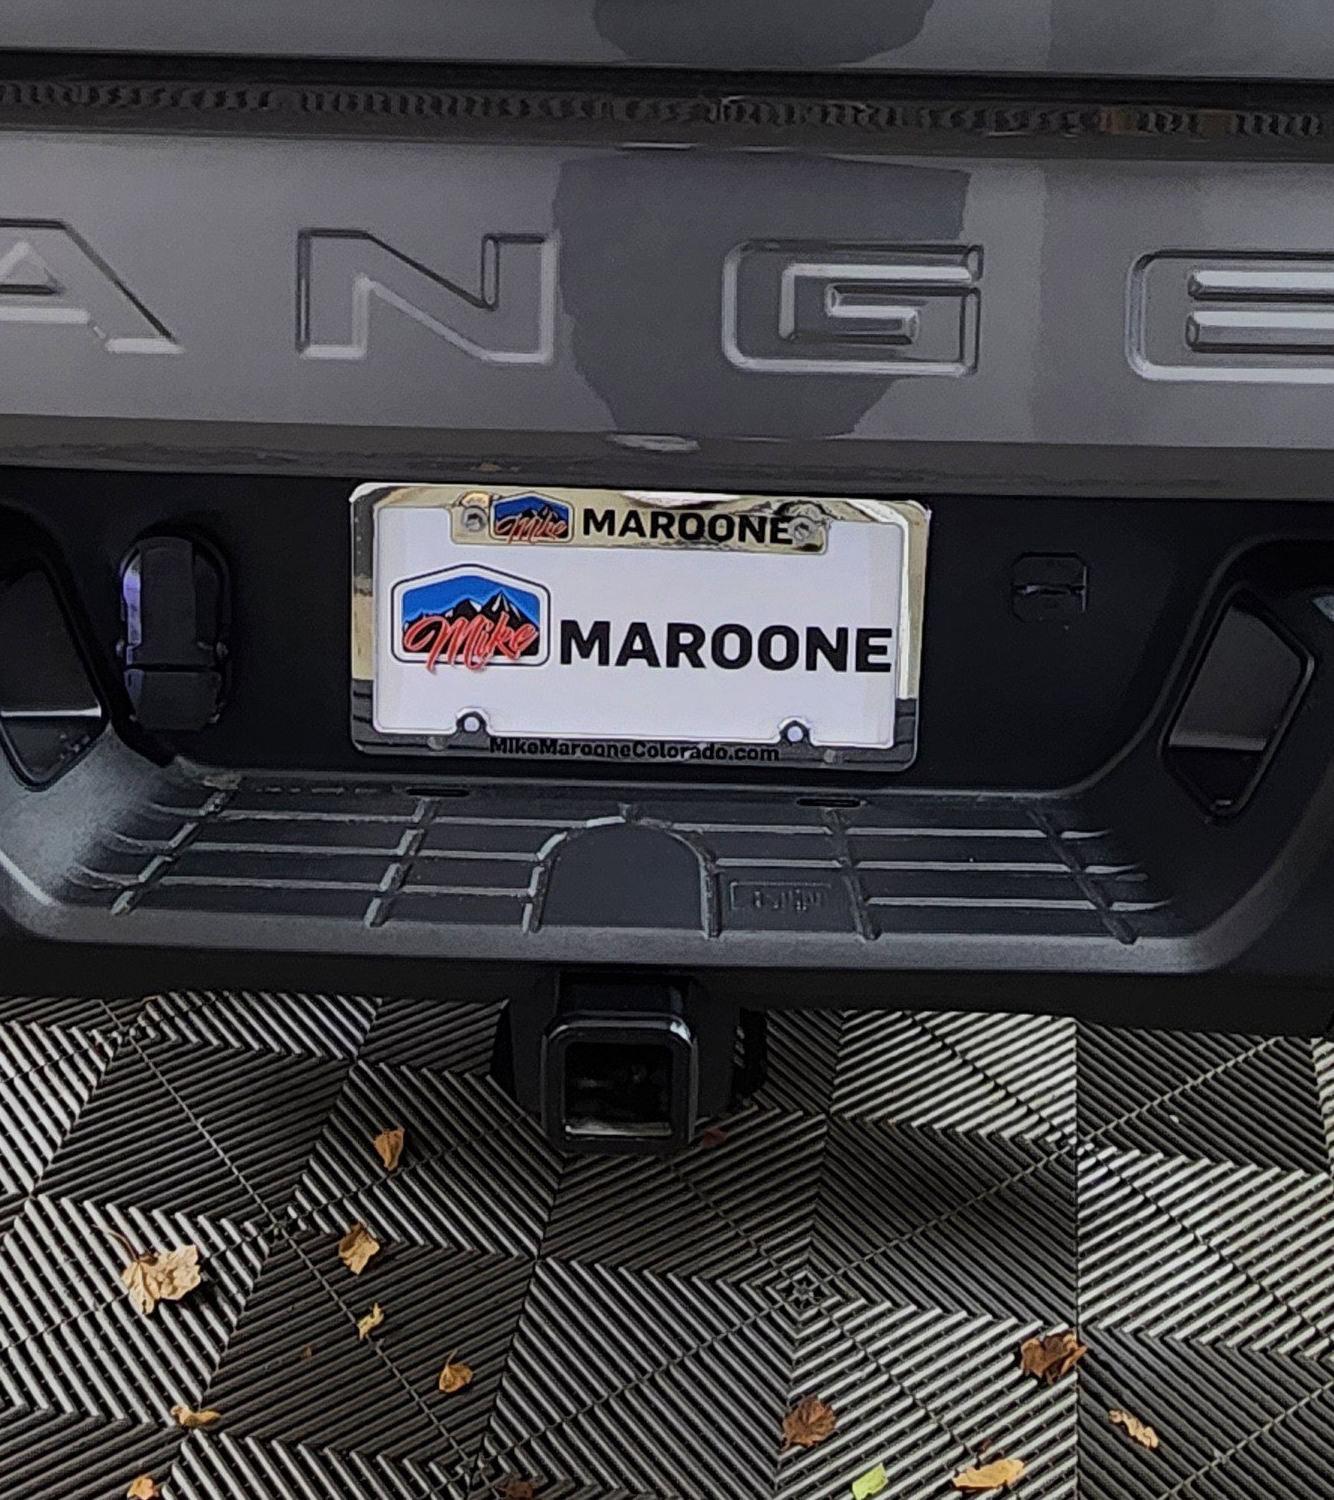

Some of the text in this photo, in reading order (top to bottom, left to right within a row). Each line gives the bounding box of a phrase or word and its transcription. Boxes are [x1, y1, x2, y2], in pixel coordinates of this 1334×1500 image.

[494, 507, 794, 546] Mike MAROONE
[402, 608, 893, 673] Mike MAROONE
[488, 736, 781, 763] MikeMarooneColorado.com
